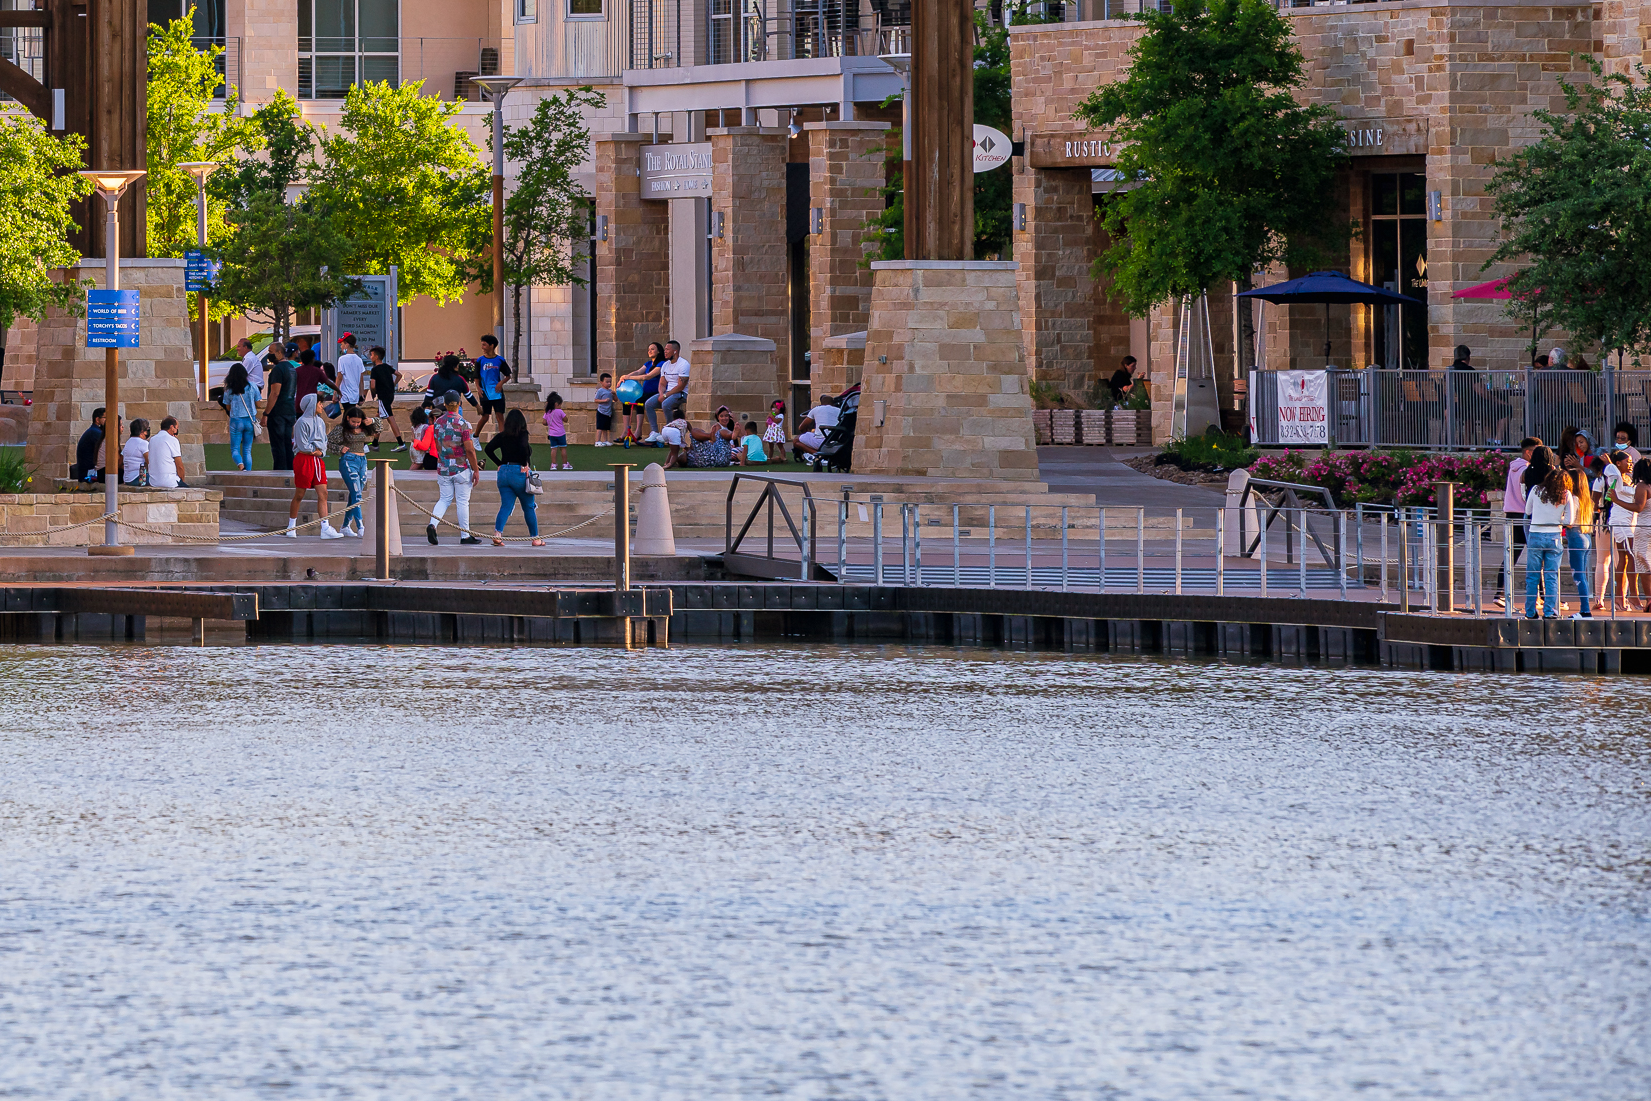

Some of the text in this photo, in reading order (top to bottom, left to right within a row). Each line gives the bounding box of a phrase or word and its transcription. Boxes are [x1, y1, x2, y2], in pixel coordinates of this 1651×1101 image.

[1344, 129, 1383, 147] SINE
[645, 152, 662, 171] THE
[665, 151, 690, 171] ROYAL
[975, 154, 1007, 162] KITCHEN
[1279, 406, 1326, 422] NOW HIRING
